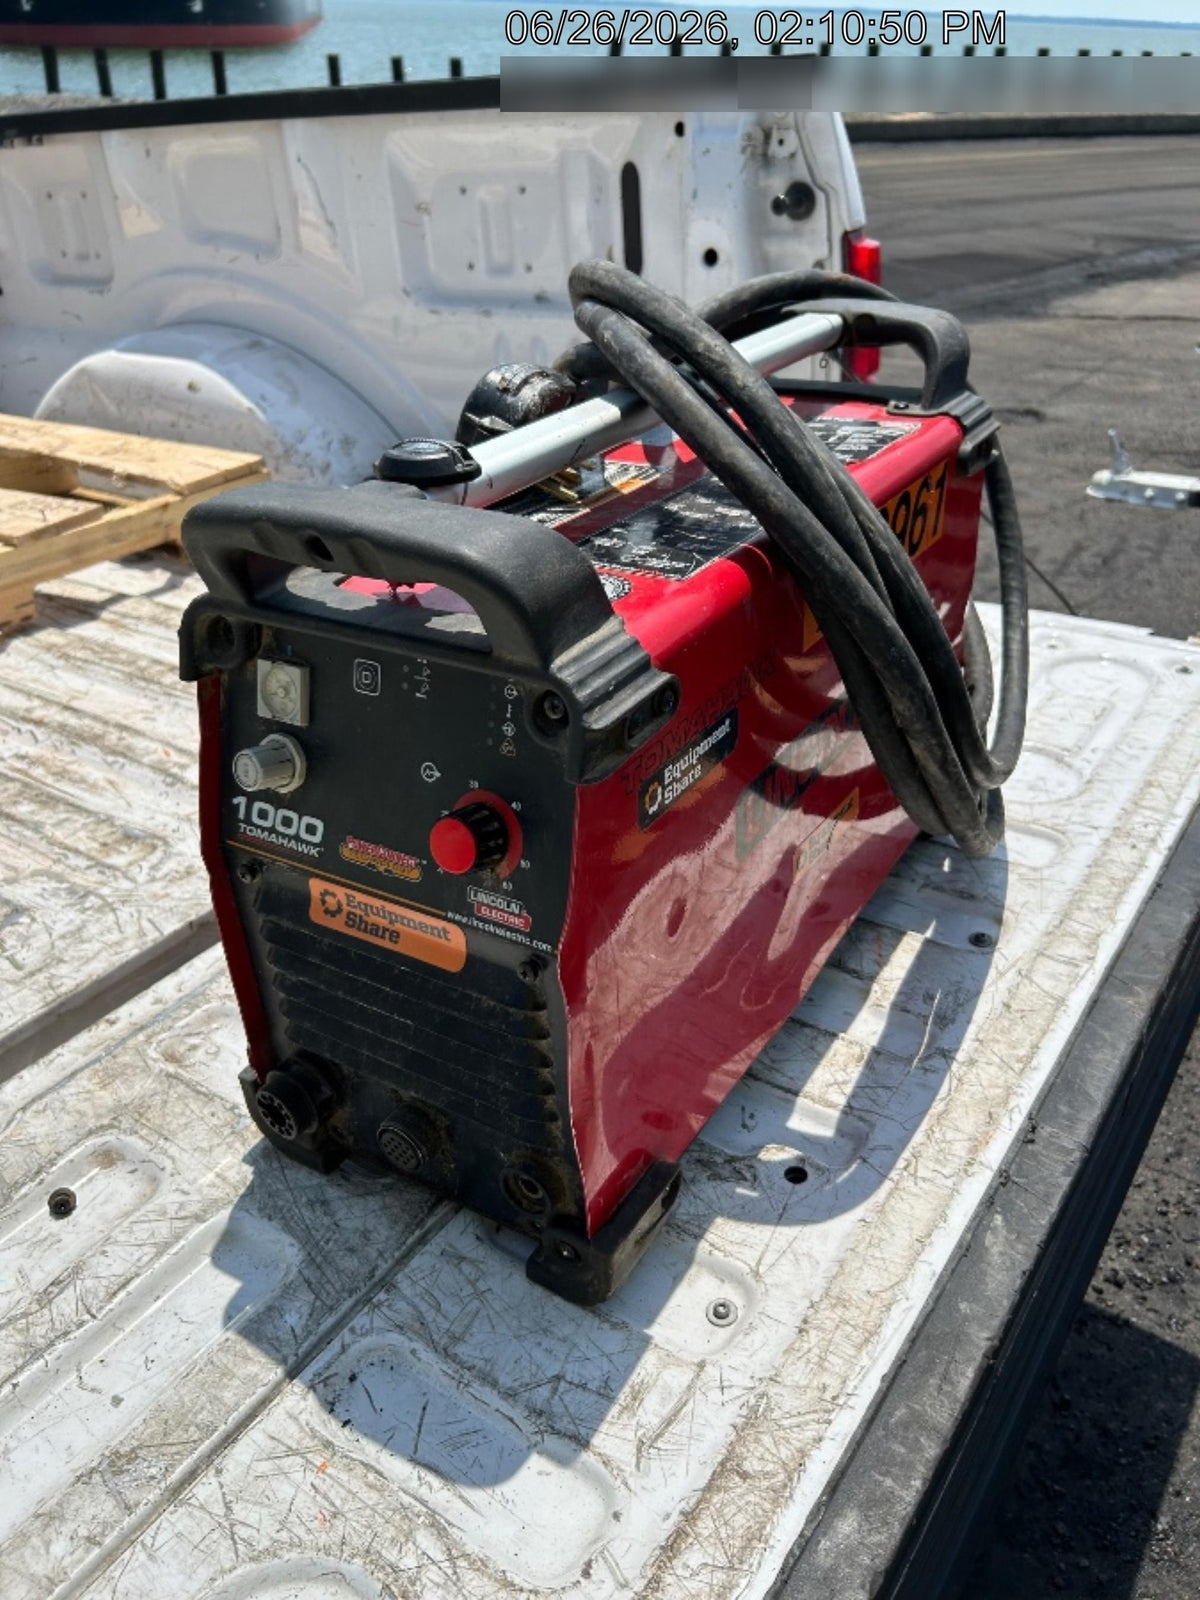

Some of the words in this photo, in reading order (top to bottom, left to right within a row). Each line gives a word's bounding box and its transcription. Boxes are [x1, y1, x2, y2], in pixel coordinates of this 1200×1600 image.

[663, 718, 731, 785] Equipment
[663, 764, 702, 805] Share
[232, 795, 325, 844] 1000
[238, 822, 320, 858] TOMAHAWK
[344, 892, 451, 941] Equipment
[470, 889, 521, 914] LINCOLN
[481, 906, 526, 928] ELECTRIC
[344, 911, 400, 944] Share
